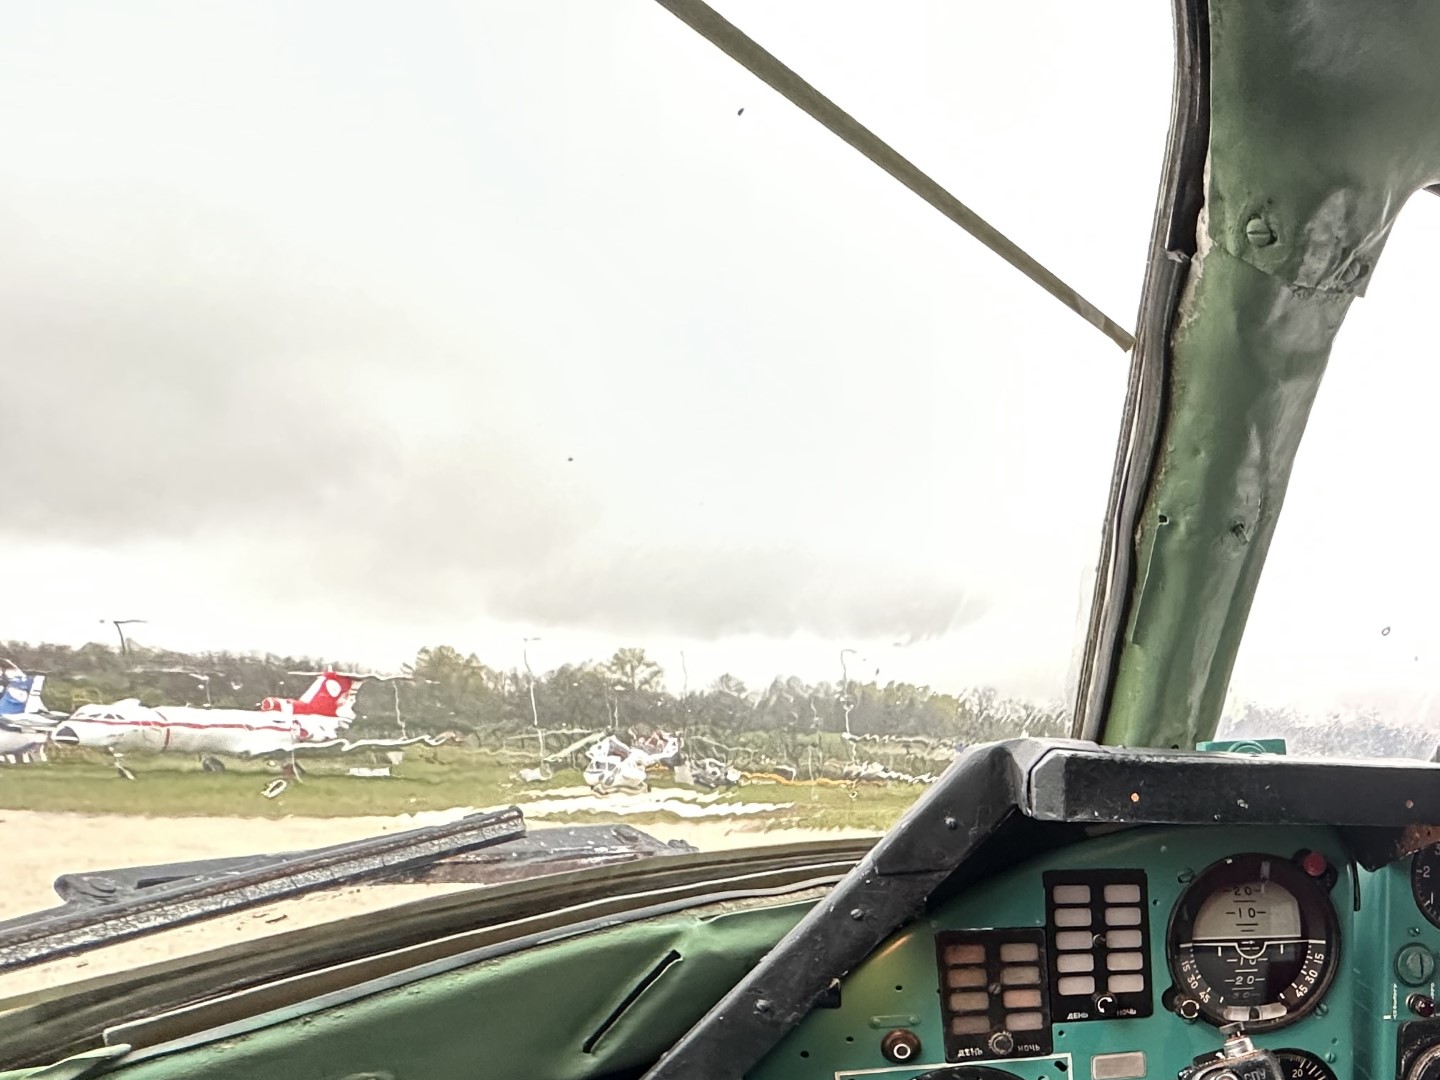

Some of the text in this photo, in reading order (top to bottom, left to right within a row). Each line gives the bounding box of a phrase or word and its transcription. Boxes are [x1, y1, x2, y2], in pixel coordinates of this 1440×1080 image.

[1422, 867, 1430, 878] 2
[1313, 953, 1325, 965] 15
[1187, 976, 1199, 989] 30
[1305, 969, 1318, 984] 30
[1292, 1068, 1303, 1079] 20
